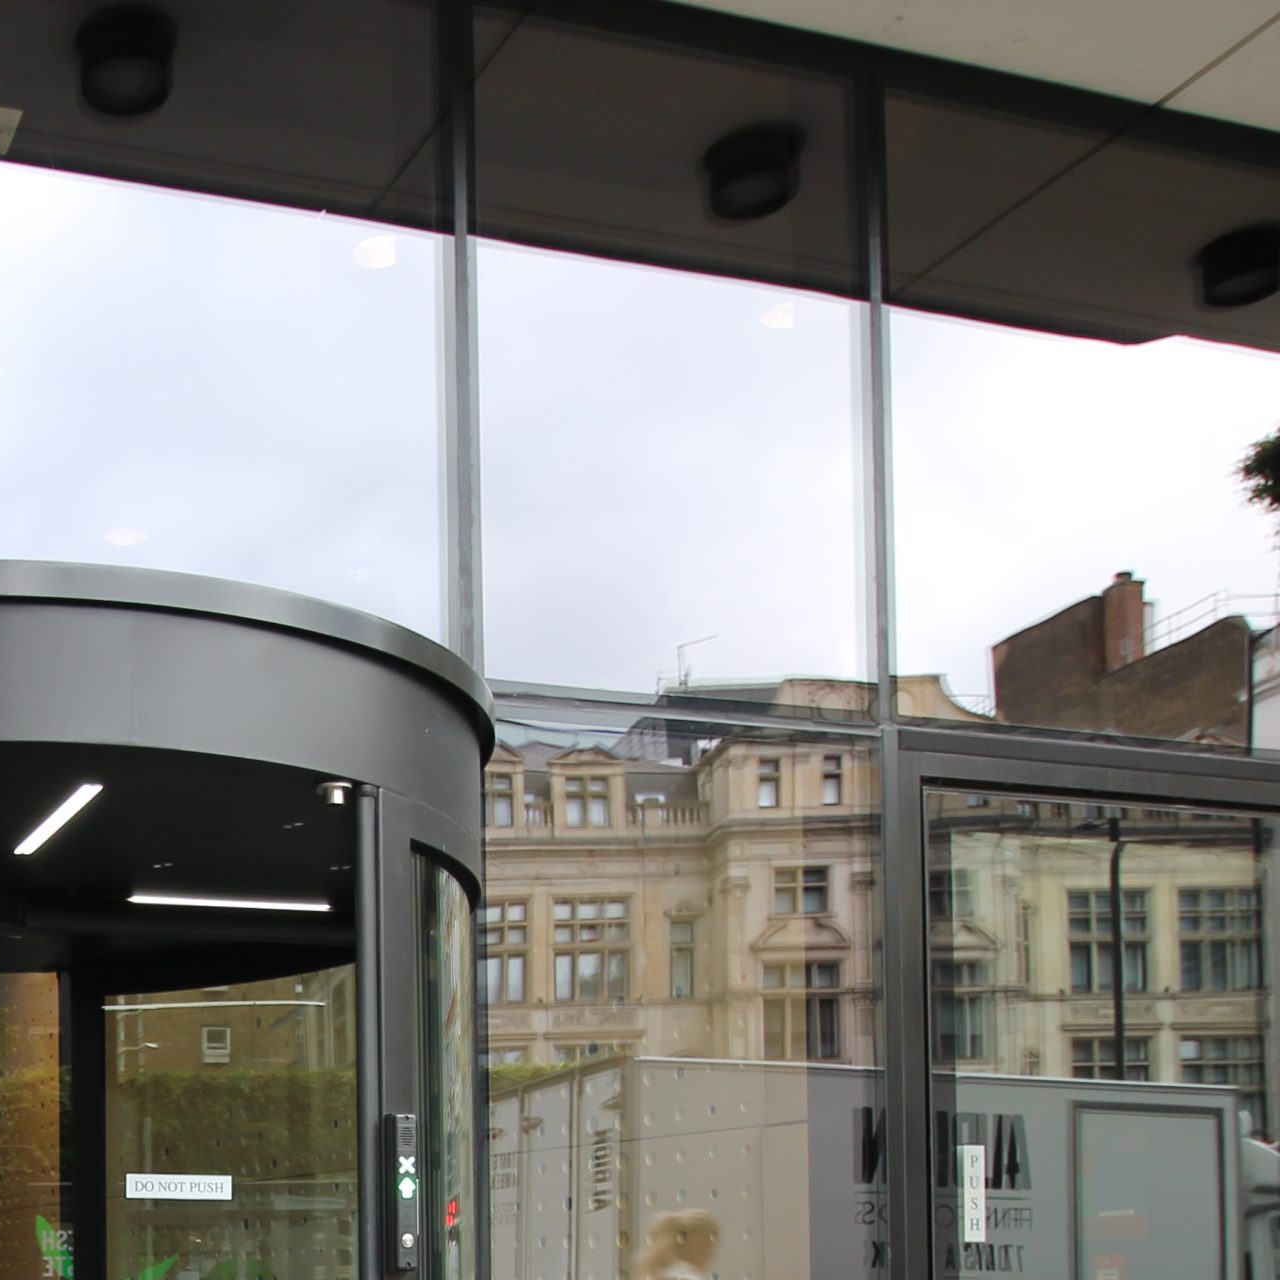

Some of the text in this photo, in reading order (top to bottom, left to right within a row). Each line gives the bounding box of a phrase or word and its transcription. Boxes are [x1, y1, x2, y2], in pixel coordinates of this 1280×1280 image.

[134, 1181, 224, 1193] DO NOT PUSH
[969, 1154, 980, 1231] PUSH
